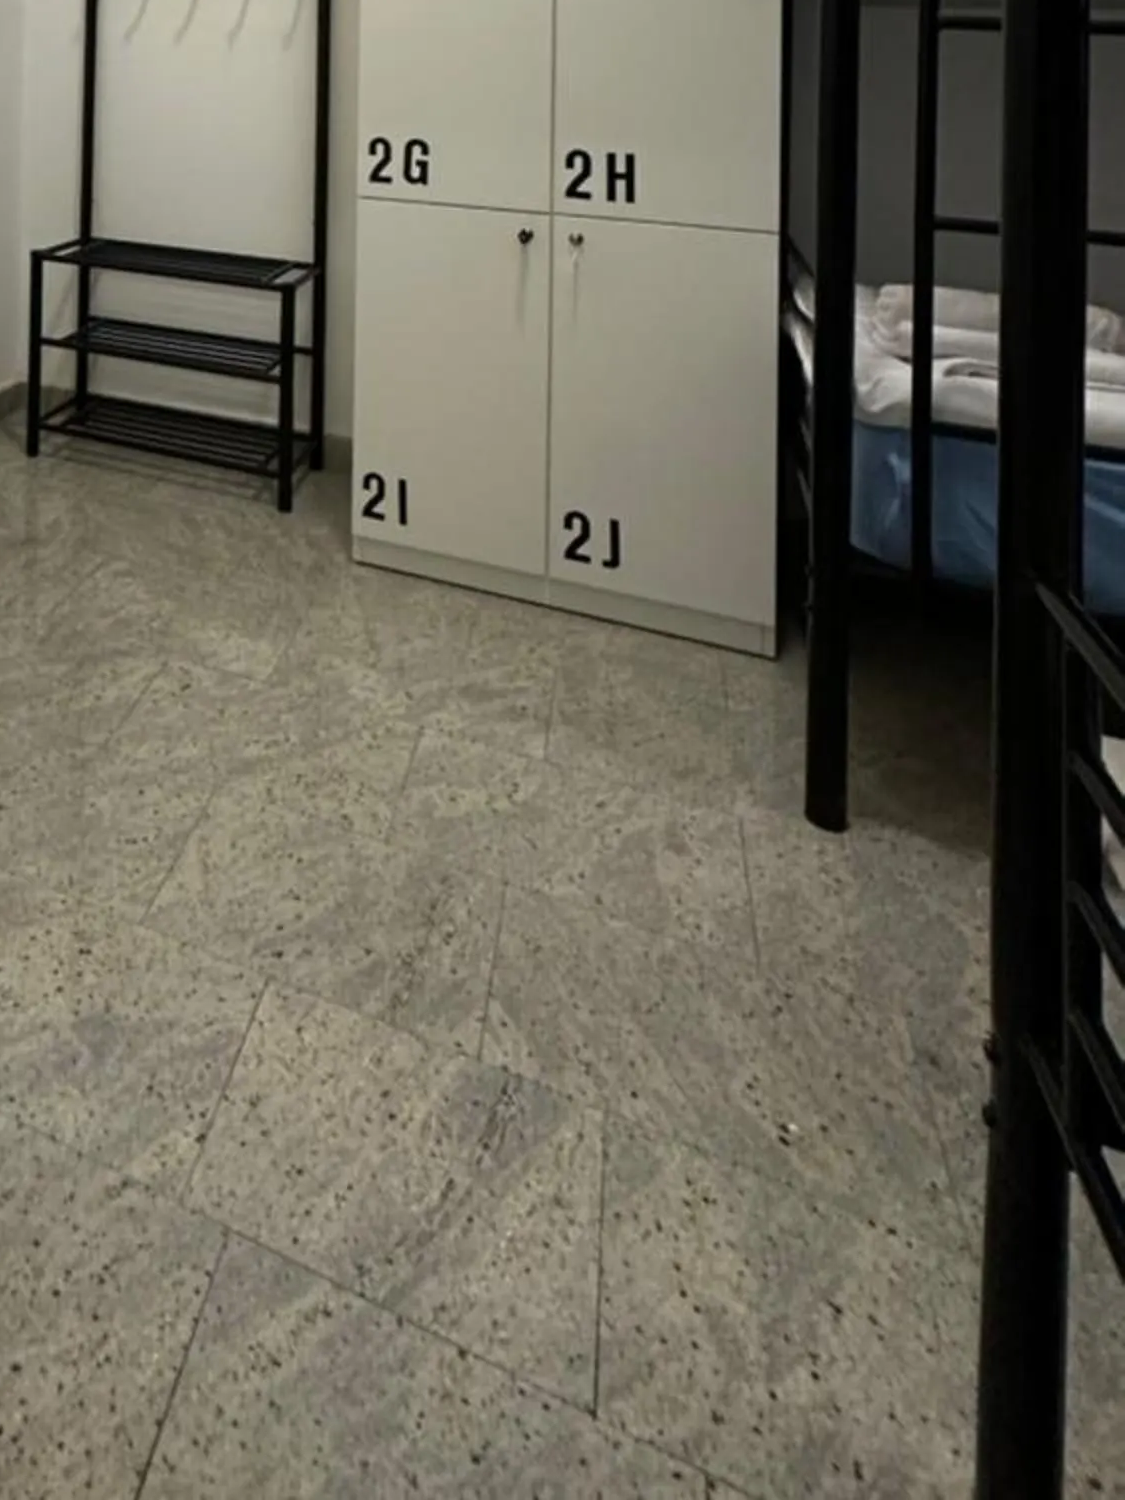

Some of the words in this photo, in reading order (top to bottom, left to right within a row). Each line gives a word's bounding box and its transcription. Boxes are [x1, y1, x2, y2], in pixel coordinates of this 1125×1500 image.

[368, 137, 430, 185] 2G
[564, 148, 636, 204] 2H
[562, 510, 620, 569] 2J
